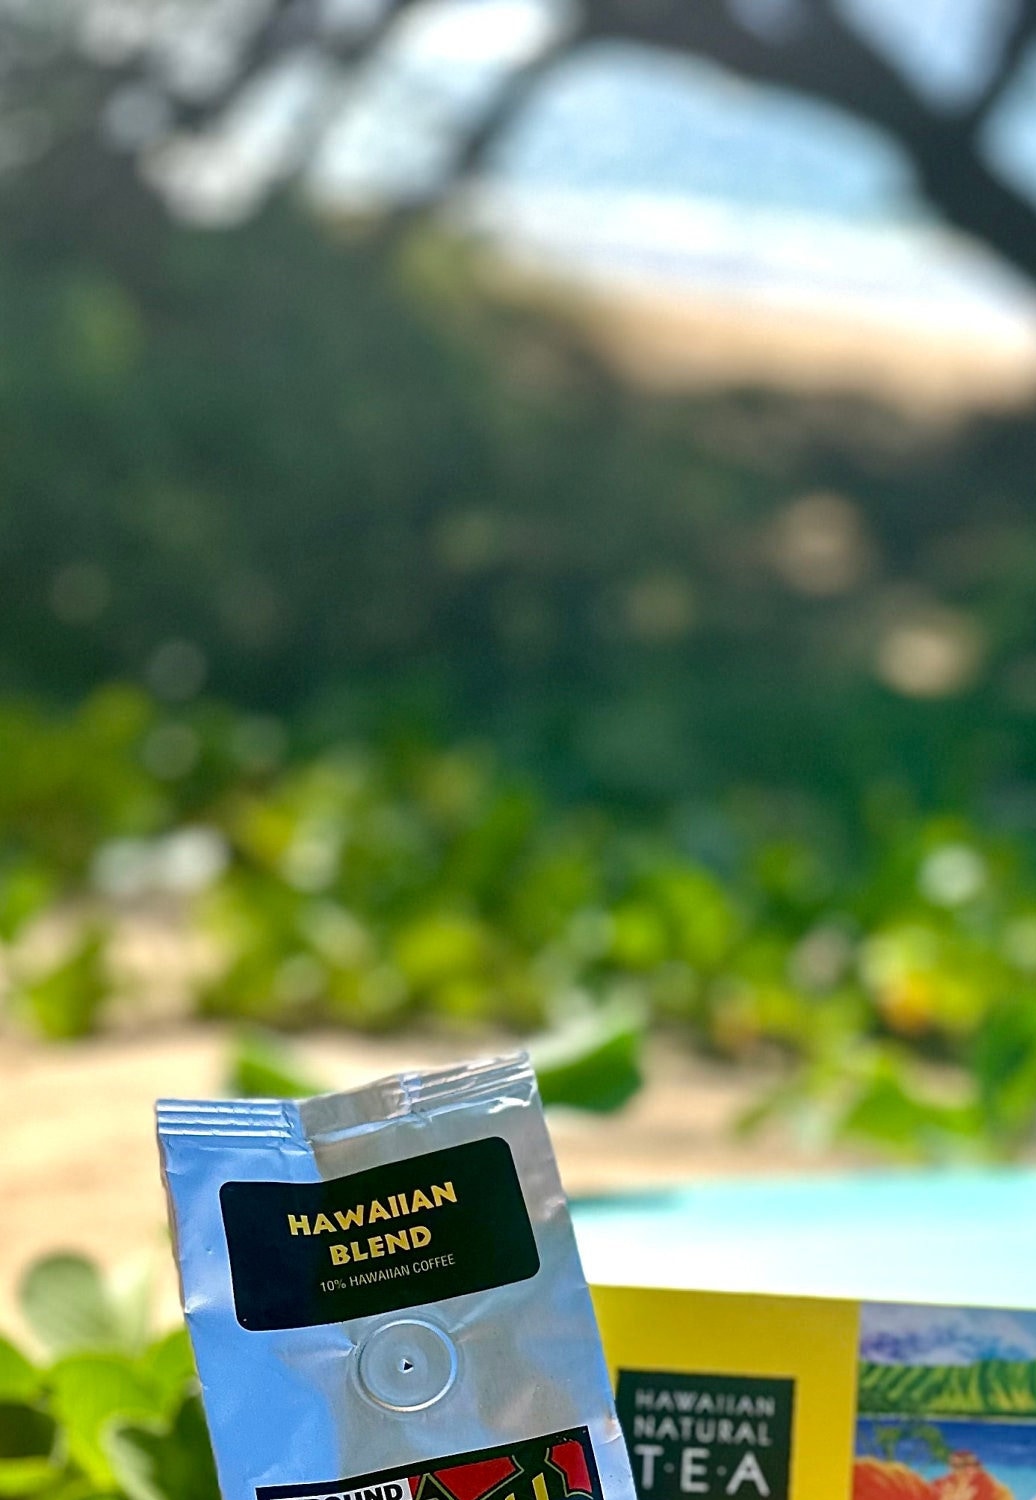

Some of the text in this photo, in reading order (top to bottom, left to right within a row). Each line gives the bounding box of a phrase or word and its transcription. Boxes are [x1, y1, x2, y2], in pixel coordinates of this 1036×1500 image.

[287, 1181, 458, 1237] HAWAIIAN
[330, 1225, 433, 1267] BLEND
[320, 1253, 456, 1293] 10% HAWAIIAN COFFEE
[634, 1387, 776, 1418] HAWAIIAN
[633, 1415, 774, 1447] NATURAL
